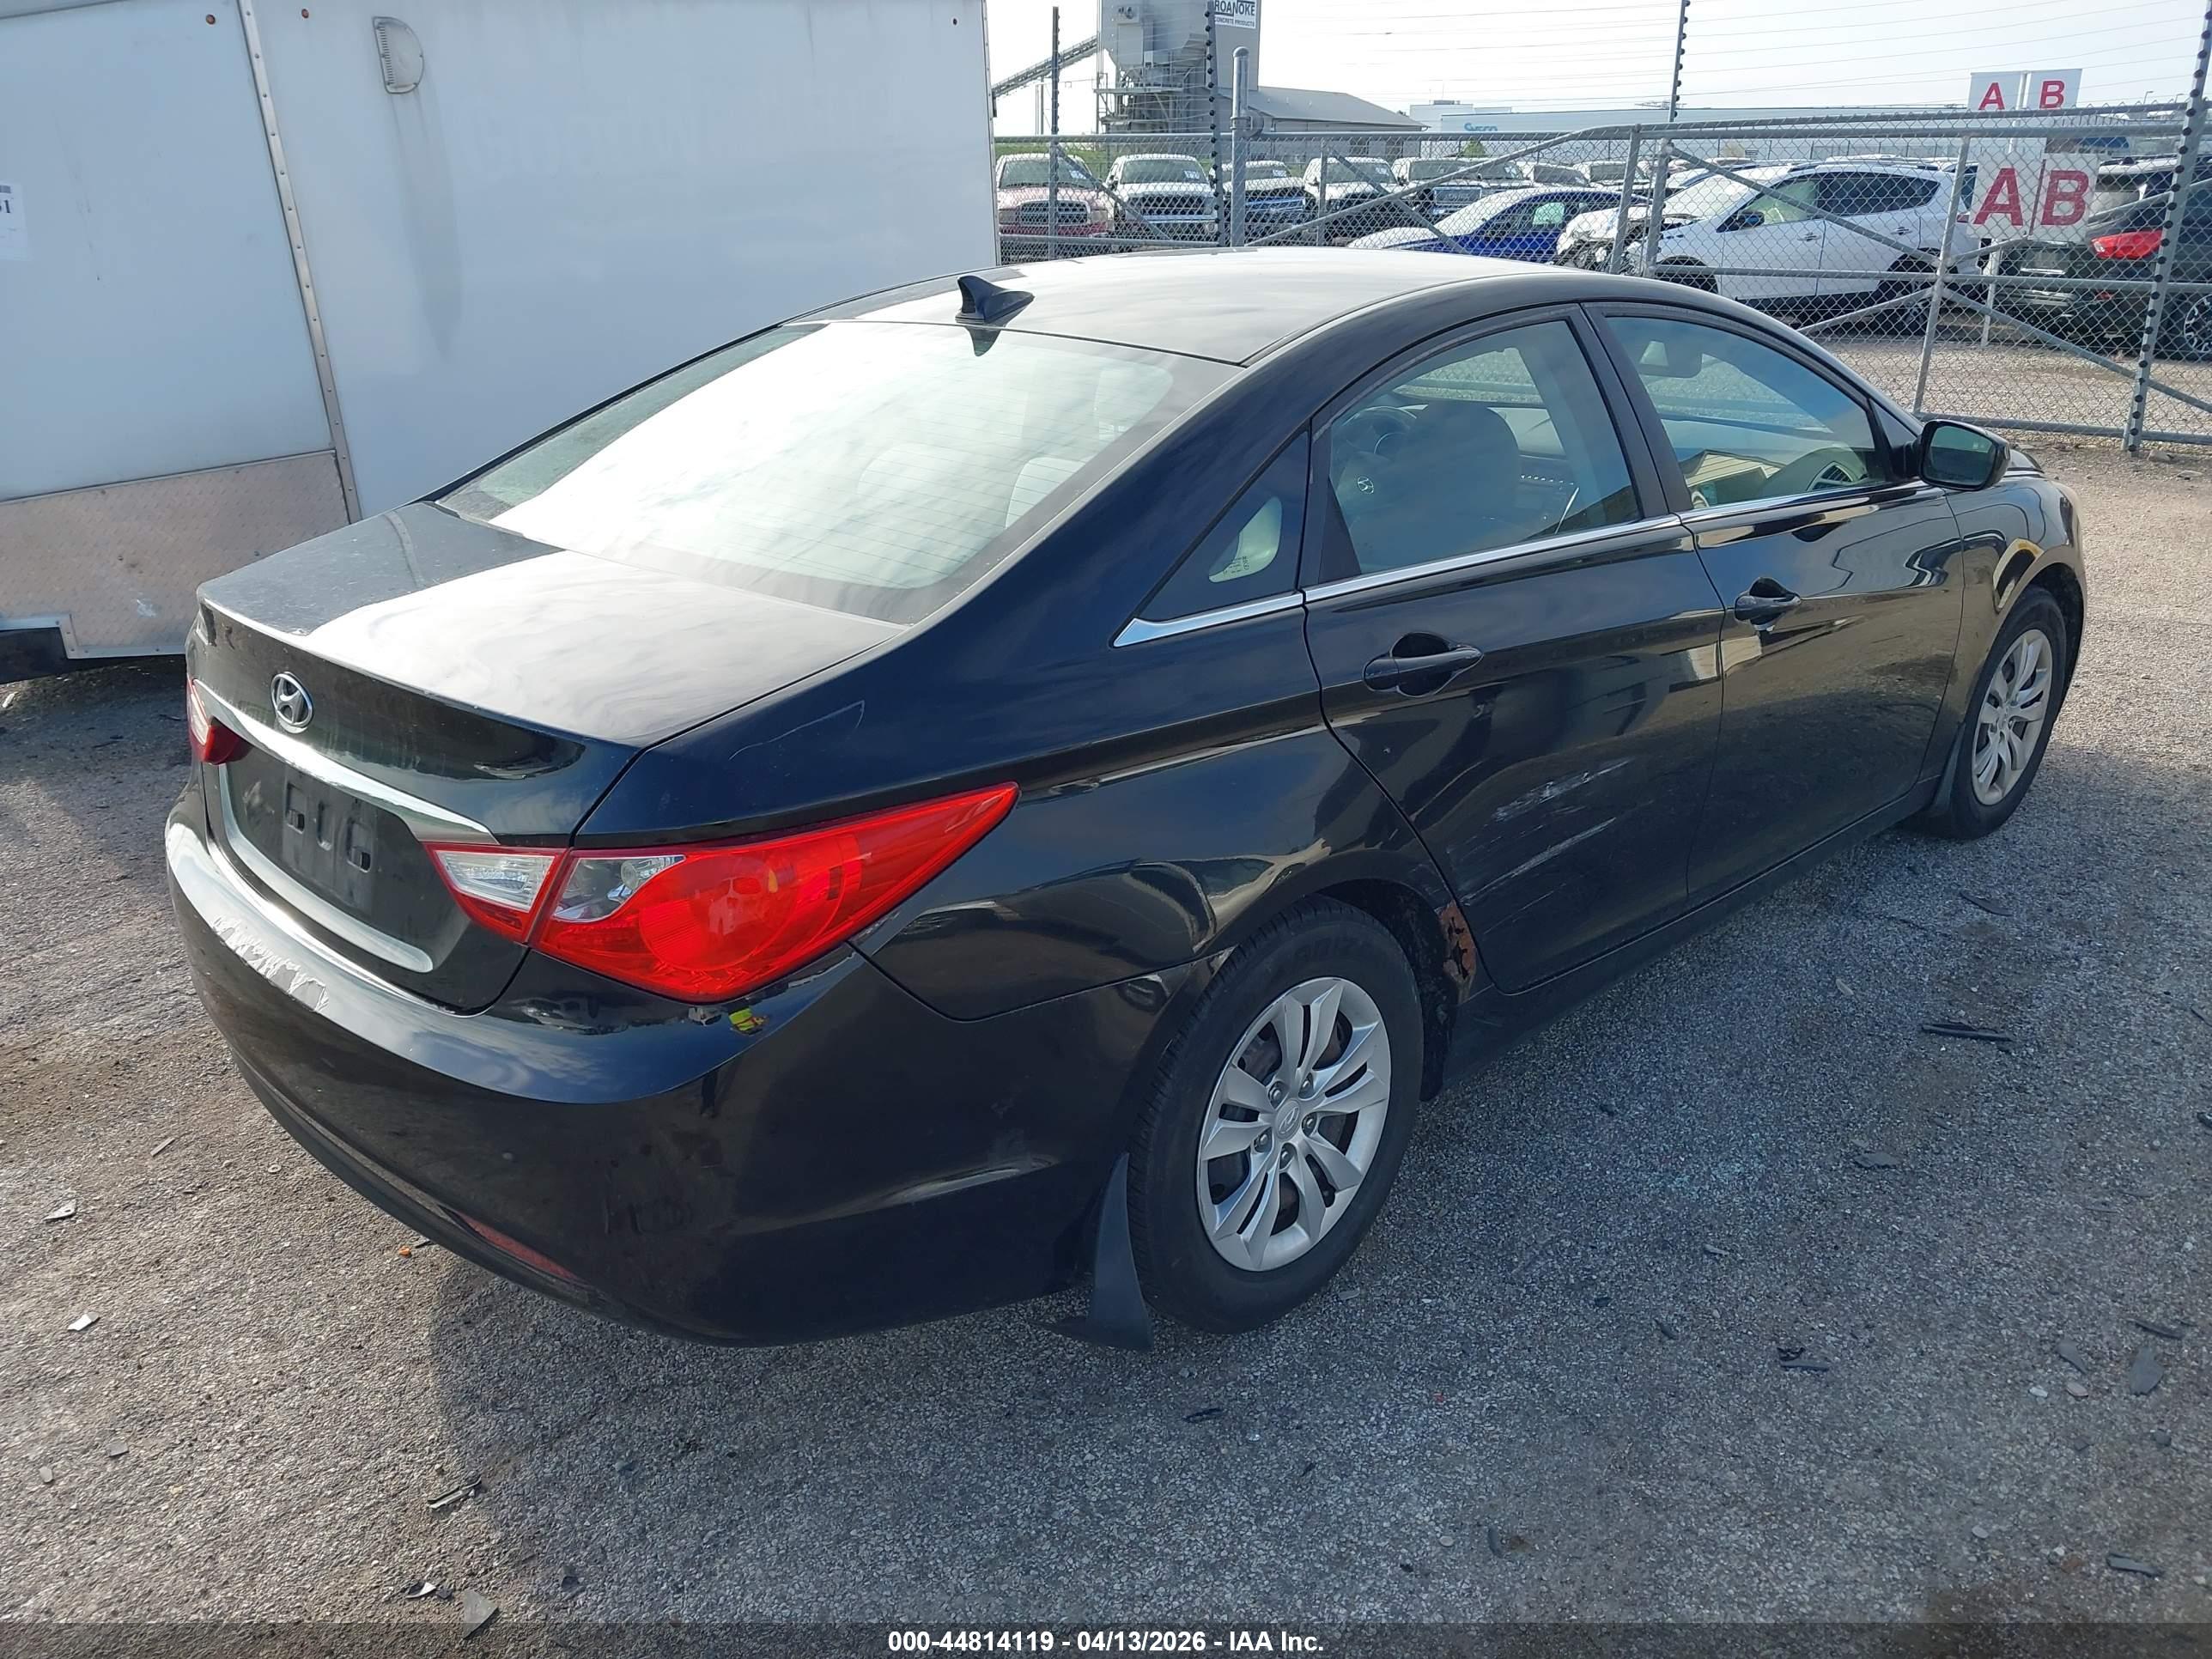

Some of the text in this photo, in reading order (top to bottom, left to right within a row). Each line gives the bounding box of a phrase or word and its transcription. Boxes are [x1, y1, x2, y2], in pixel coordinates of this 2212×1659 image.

[1214, 0, 1255, 15] ROANOKE
[1978, 80, 2065, 110] A B
[1972, 167, 2089, 227] A B
